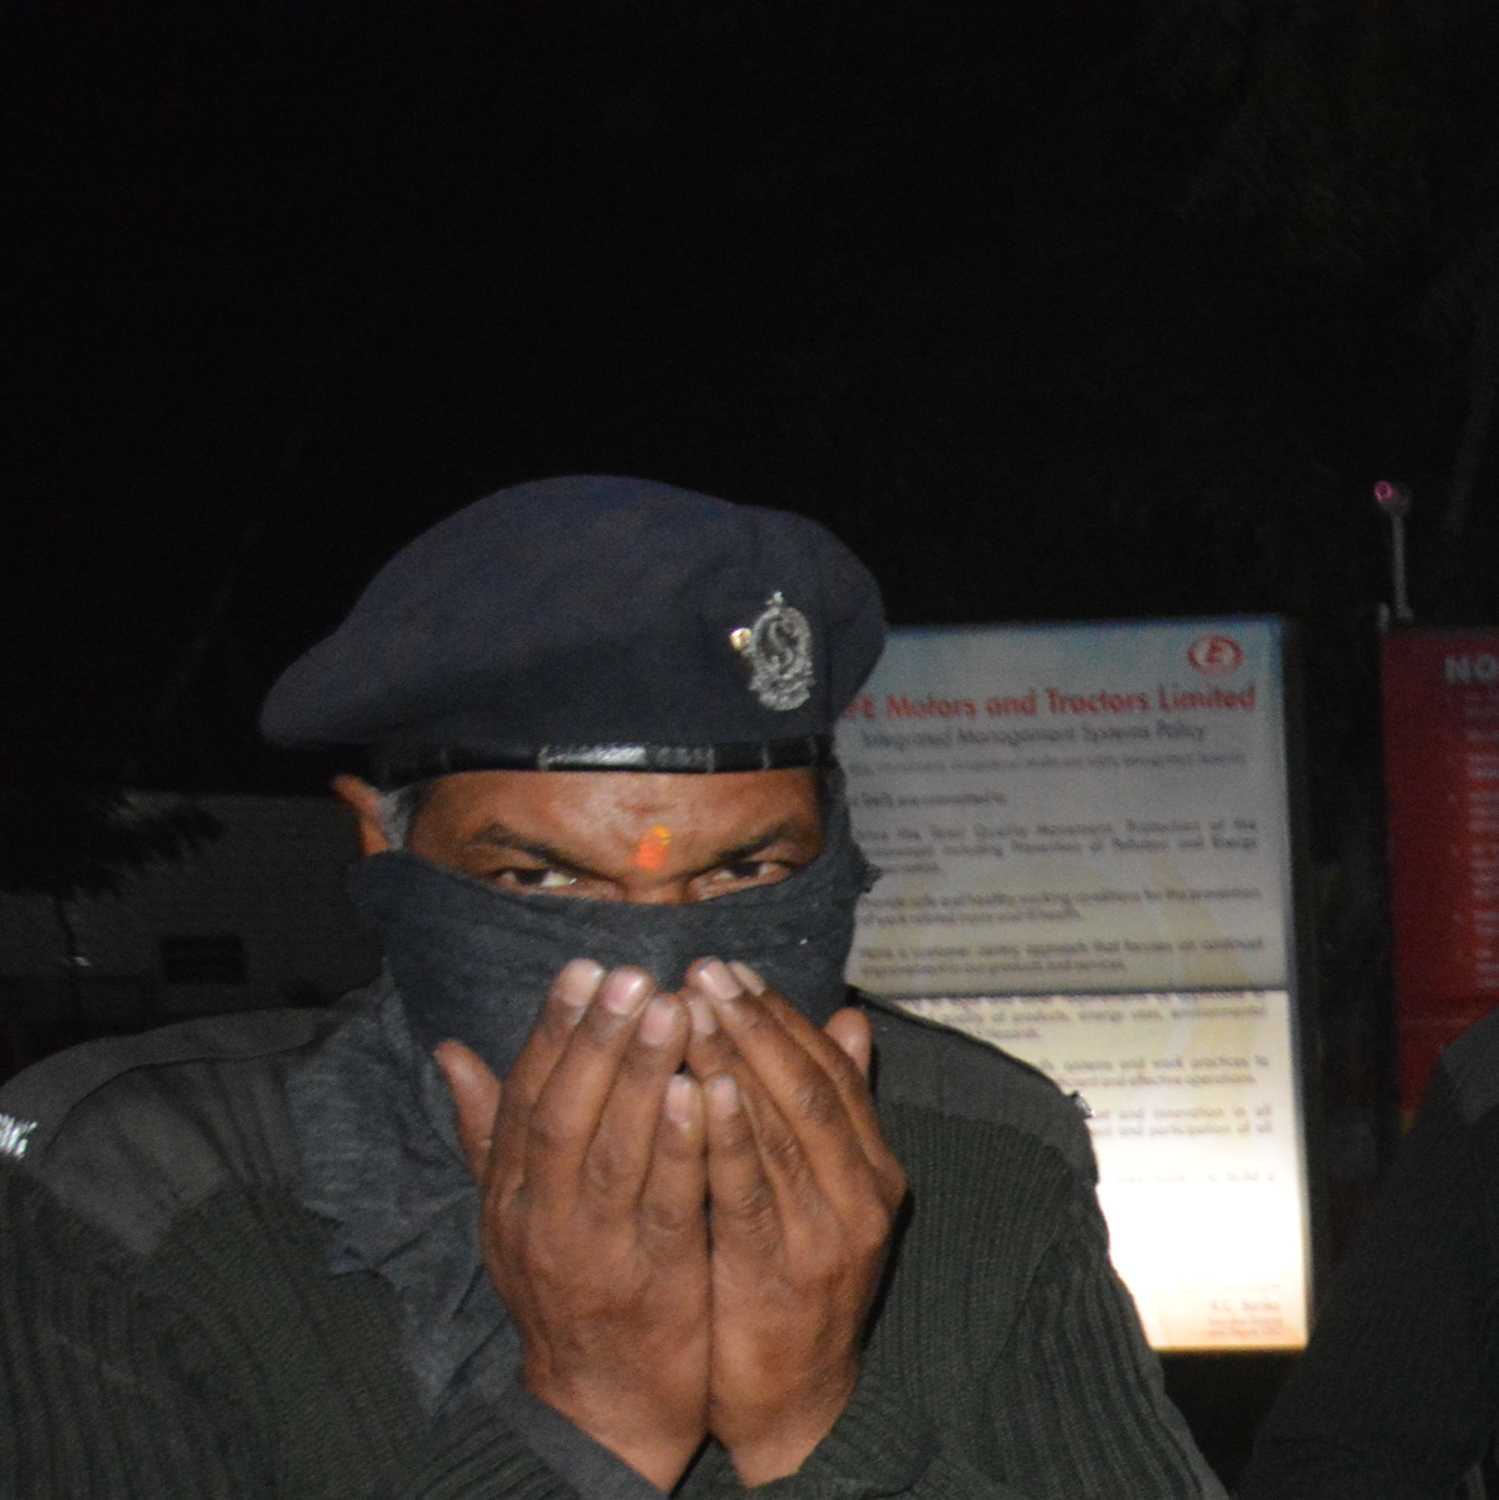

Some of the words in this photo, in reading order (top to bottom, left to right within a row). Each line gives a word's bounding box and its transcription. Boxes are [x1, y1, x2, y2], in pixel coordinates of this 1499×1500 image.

[886, 692, 978, 721] Motors
[985, 686, 1038, 718] and
[1045, 685, 1149, 714] Tractors
[1158, 682, 1257, 712] Limited
